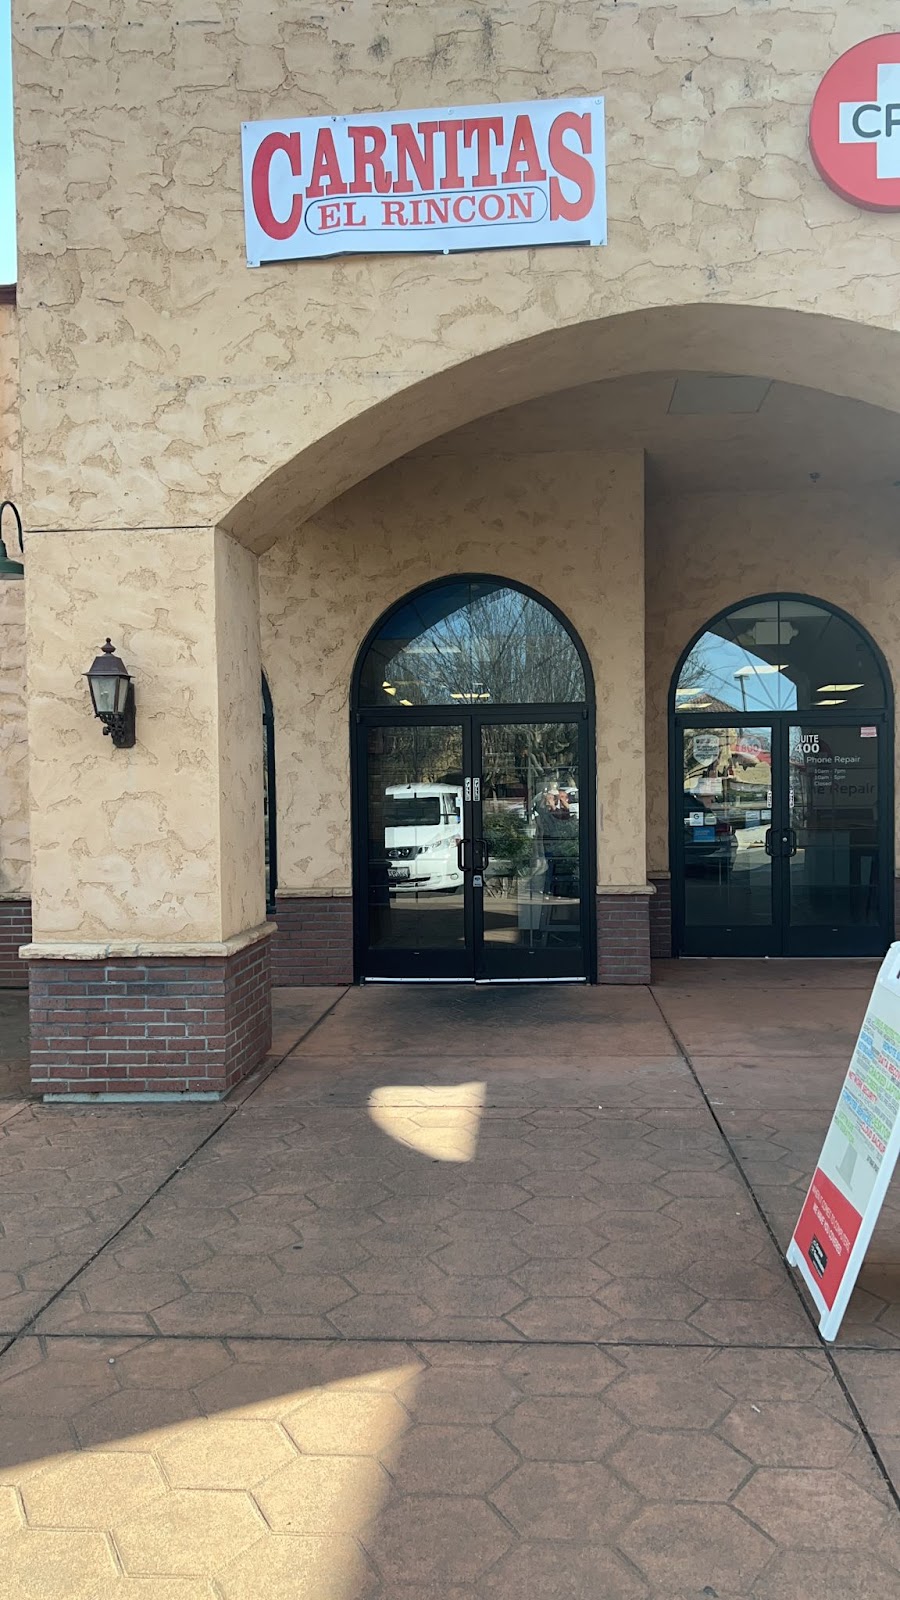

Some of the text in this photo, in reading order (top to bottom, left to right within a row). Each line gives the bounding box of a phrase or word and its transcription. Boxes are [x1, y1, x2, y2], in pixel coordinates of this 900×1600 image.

[251, 111, 596, 240] CARNITAS
[317, 192, 535, 230] EL RINCON
[794, 734, 819, 743] SUITE
[795, 743, 820, 754] 400
[806, 756, 833, 764] Phone
[834, 755, 861, 765] Repair
